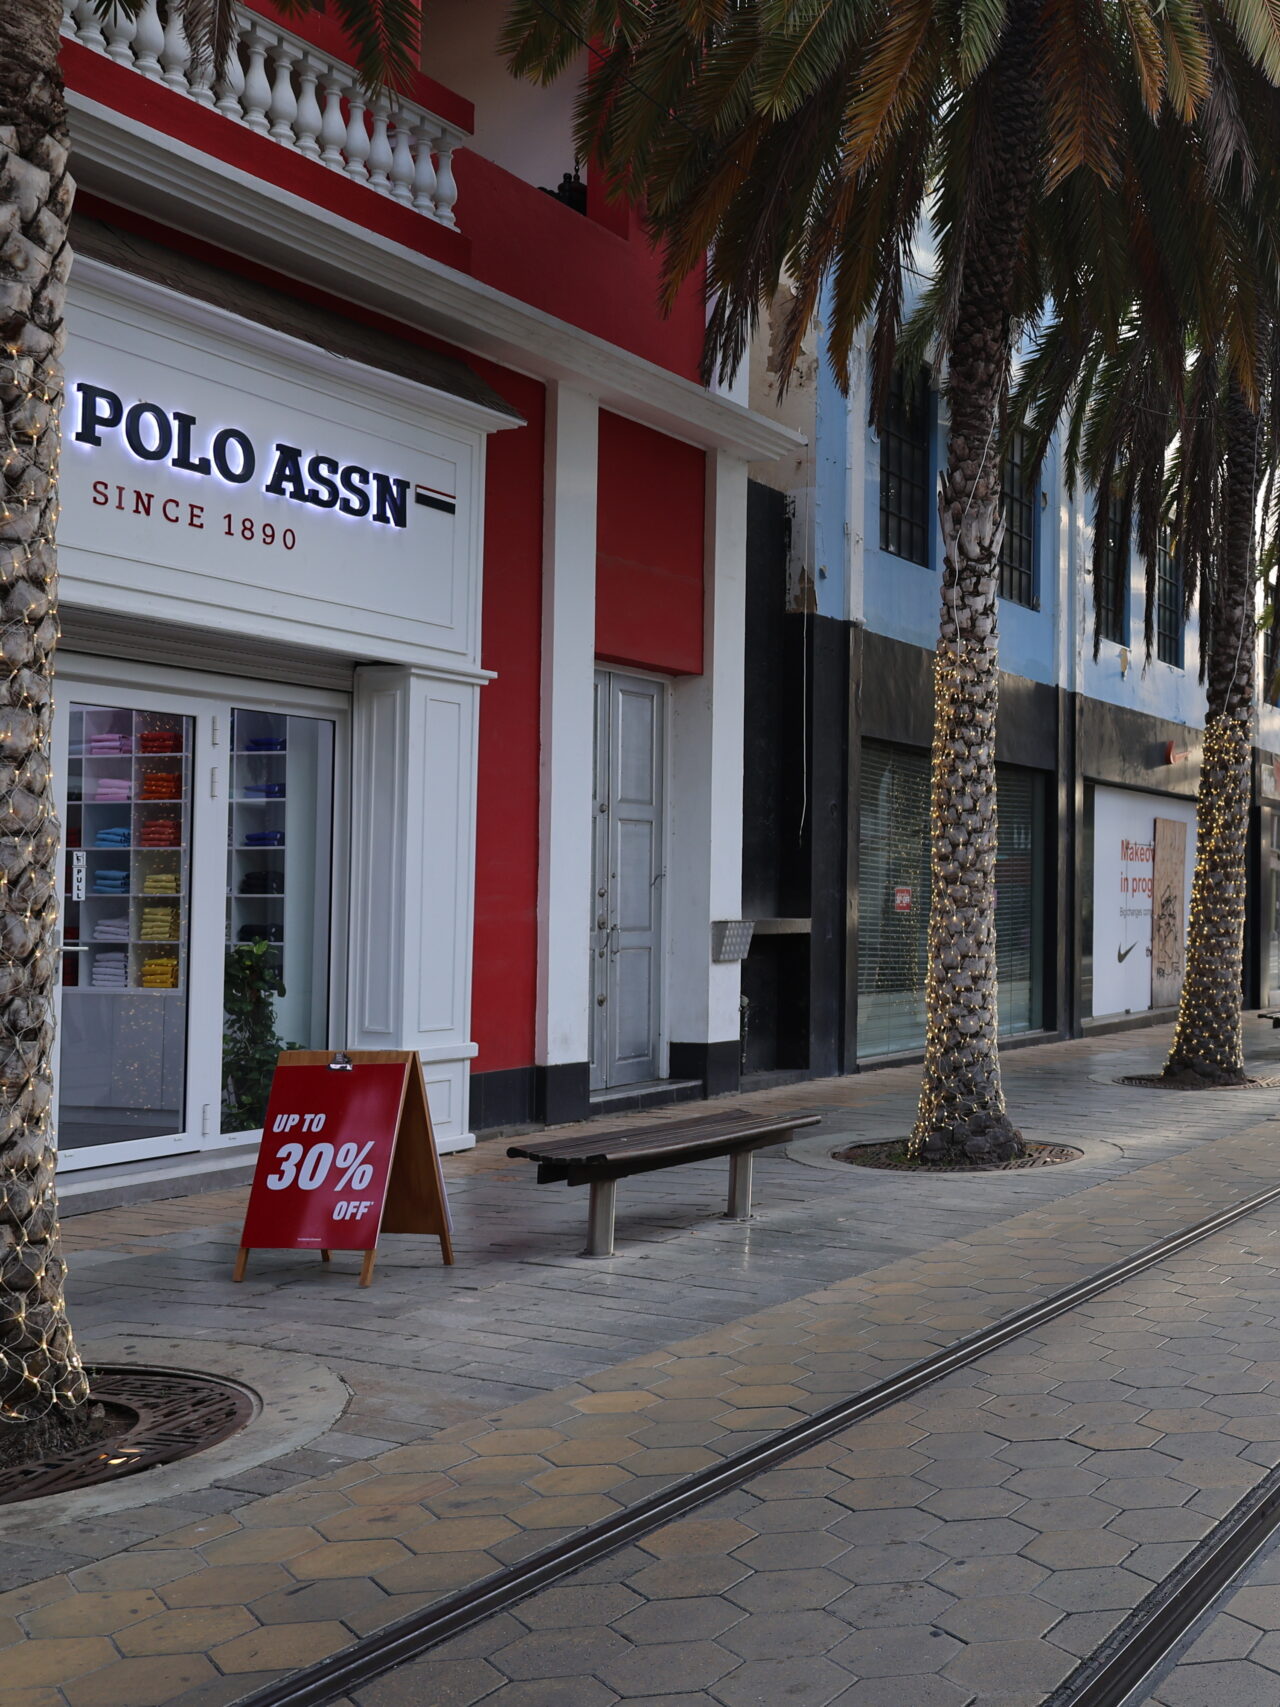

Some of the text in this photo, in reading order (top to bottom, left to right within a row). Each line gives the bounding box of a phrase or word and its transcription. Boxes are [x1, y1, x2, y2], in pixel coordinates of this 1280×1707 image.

[74, 382, 410, 528] POLO ASSN
[92, 480, 297, 550] SINCE 1890
[1120, 872, 1129, 893] in
[272, 1113, 326, 1133] UP TO
[266, 1140, 376, 1192] 30%
